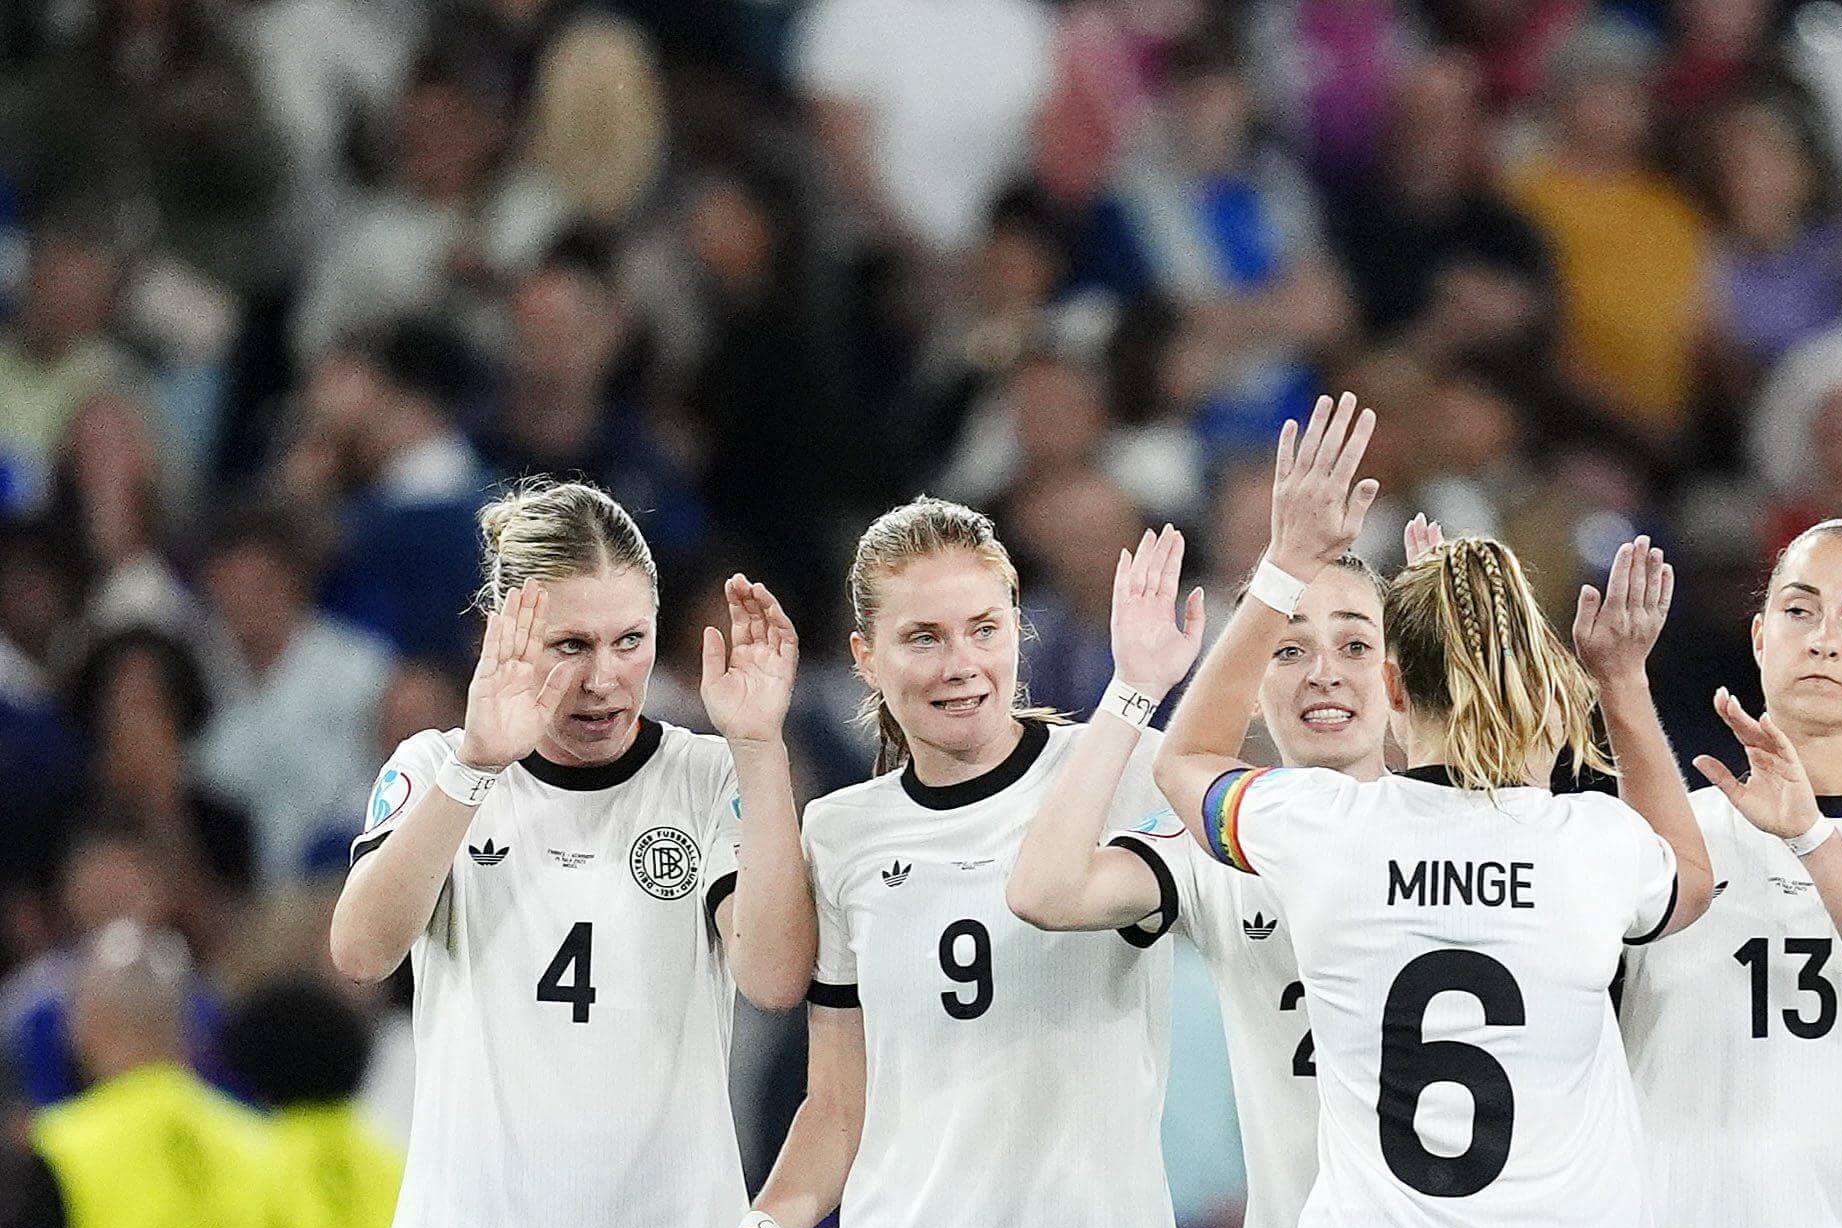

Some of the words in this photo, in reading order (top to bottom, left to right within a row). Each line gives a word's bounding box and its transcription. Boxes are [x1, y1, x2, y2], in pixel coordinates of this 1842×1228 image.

[1387, 859, 1535, 909] MINGE
[536, 921, 596, 1024] 4
[938, 918, 994, 1020] 9
[1733, 937, 1838, 1040] 13
[1375, 948, 1526, 1198] 6
